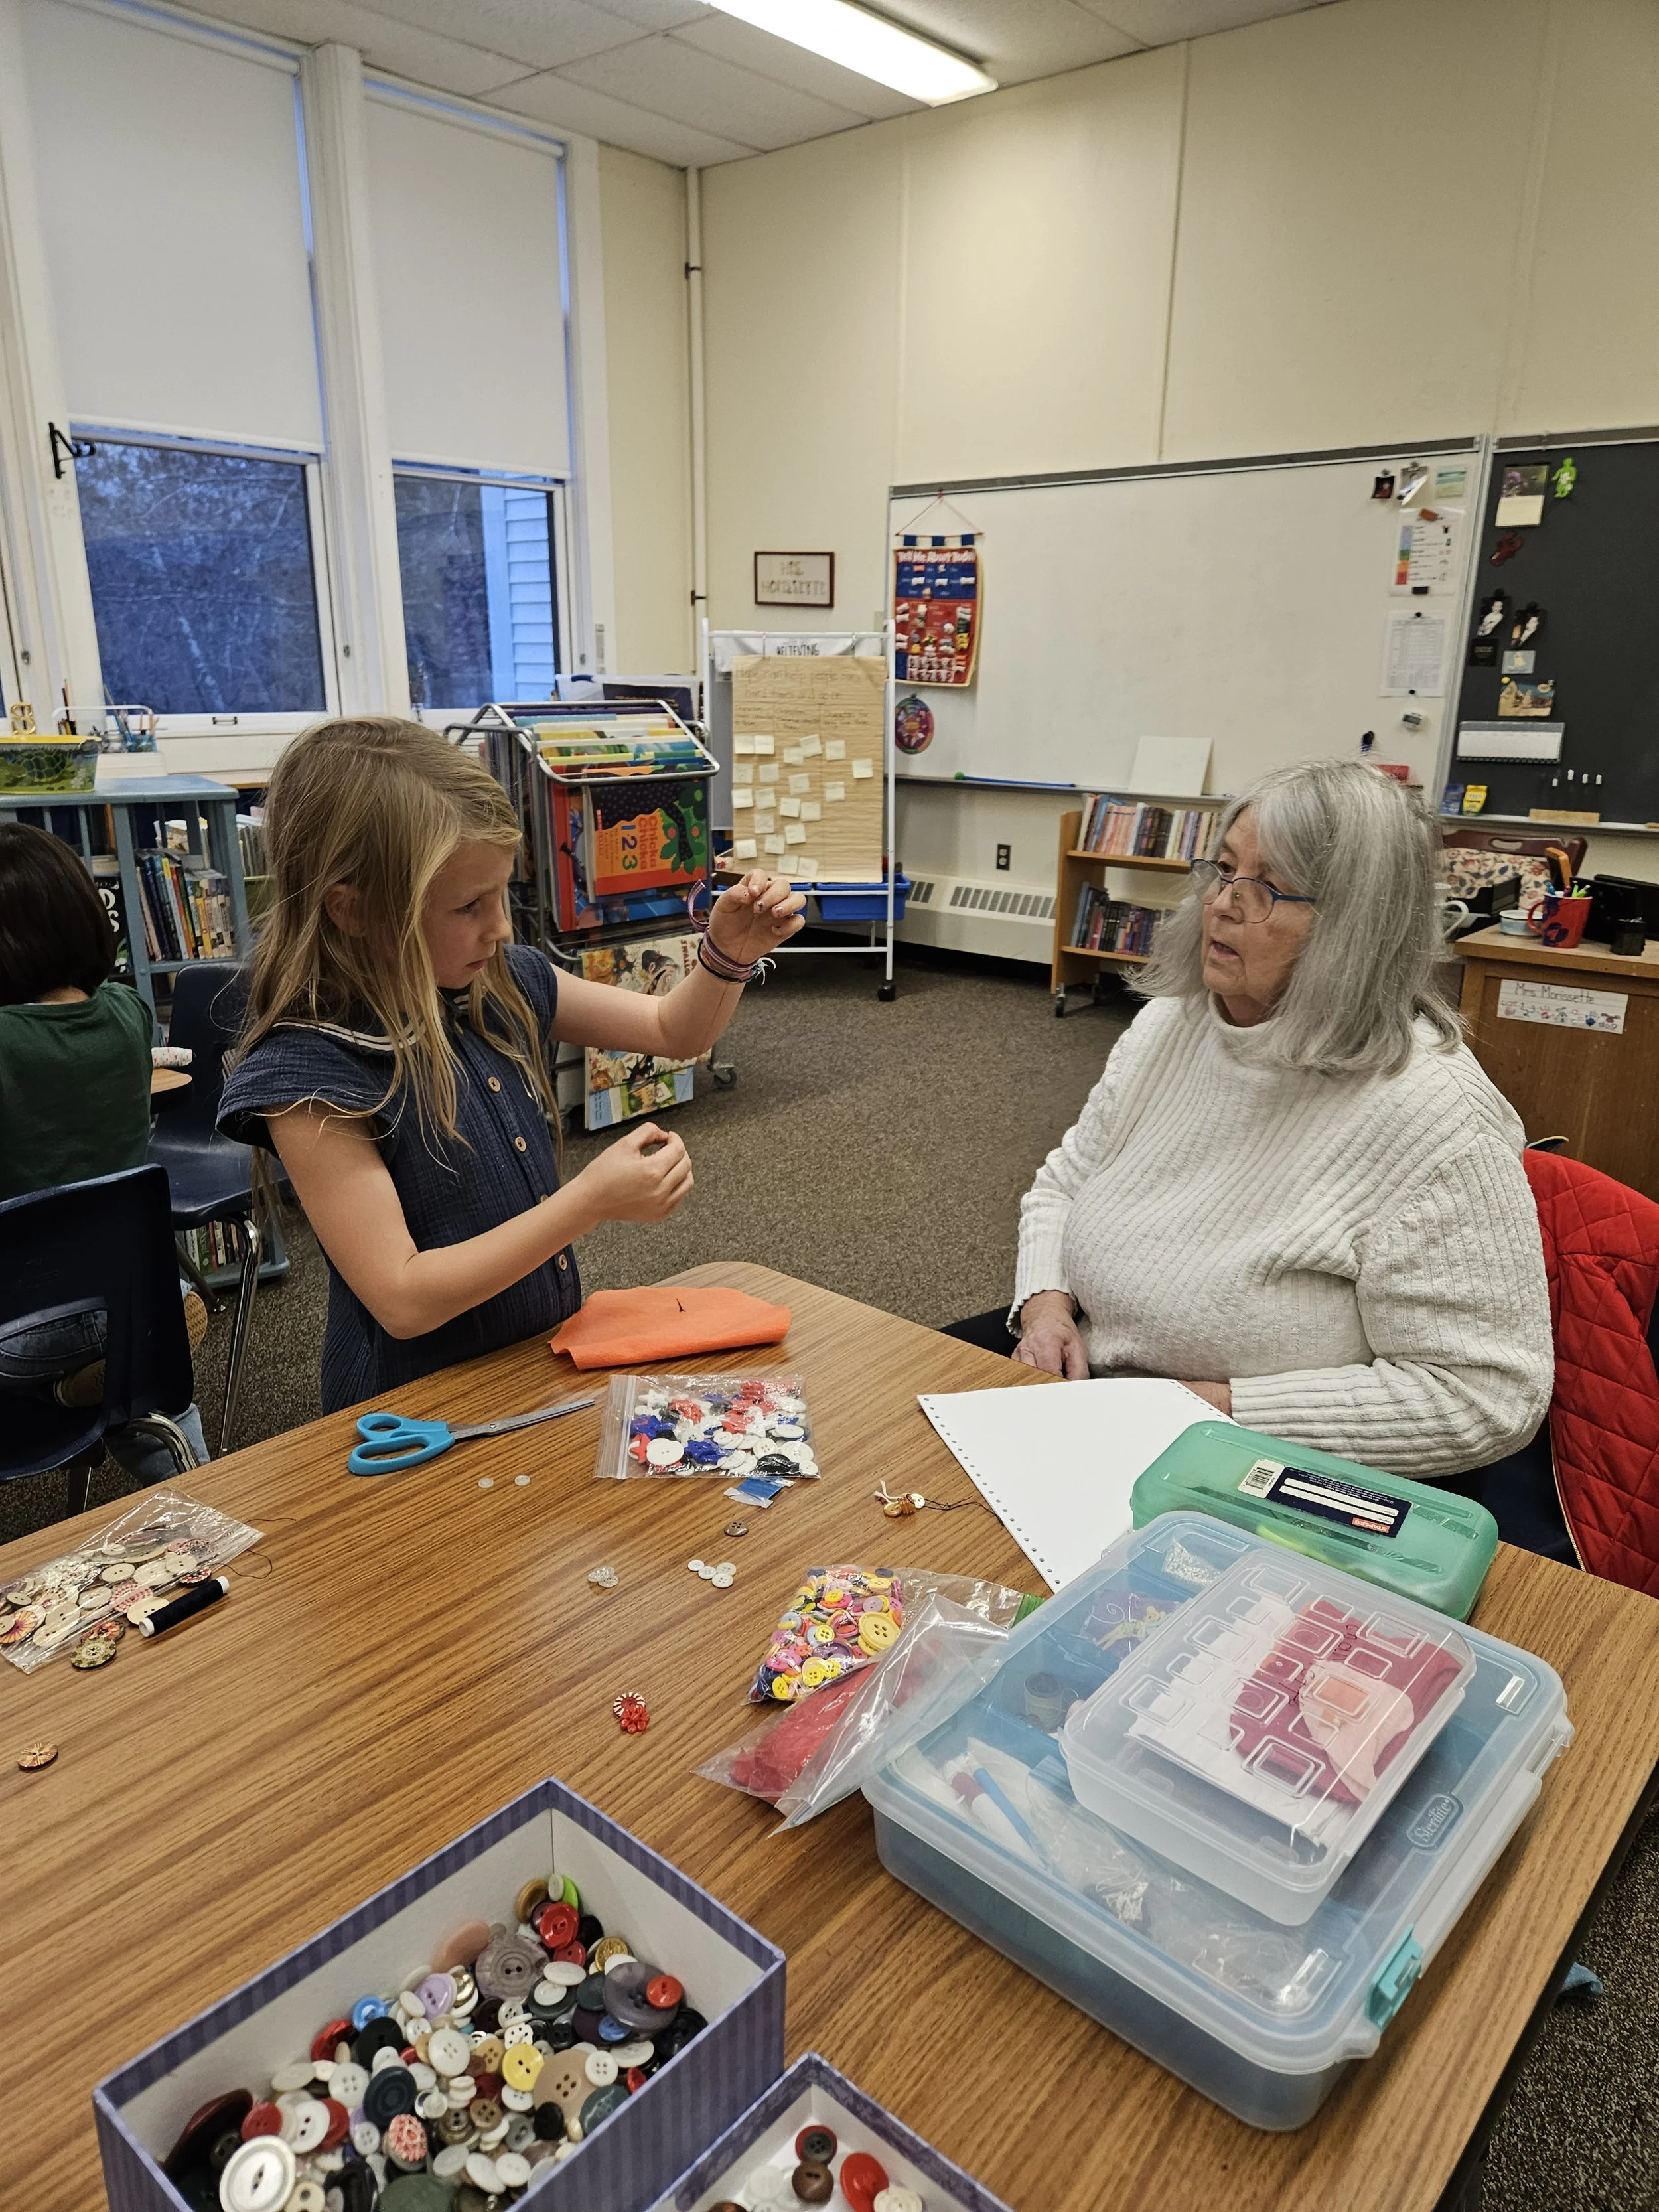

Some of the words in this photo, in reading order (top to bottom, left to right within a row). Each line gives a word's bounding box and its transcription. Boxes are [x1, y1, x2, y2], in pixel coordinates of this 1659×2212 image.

[638, 817, 648, 871] Chicka
[648, 816, 658, 868] Chicka
[681, 938, 691, 978] SWALLO
[1354, 1519, 1388, 1532] STAPLES
